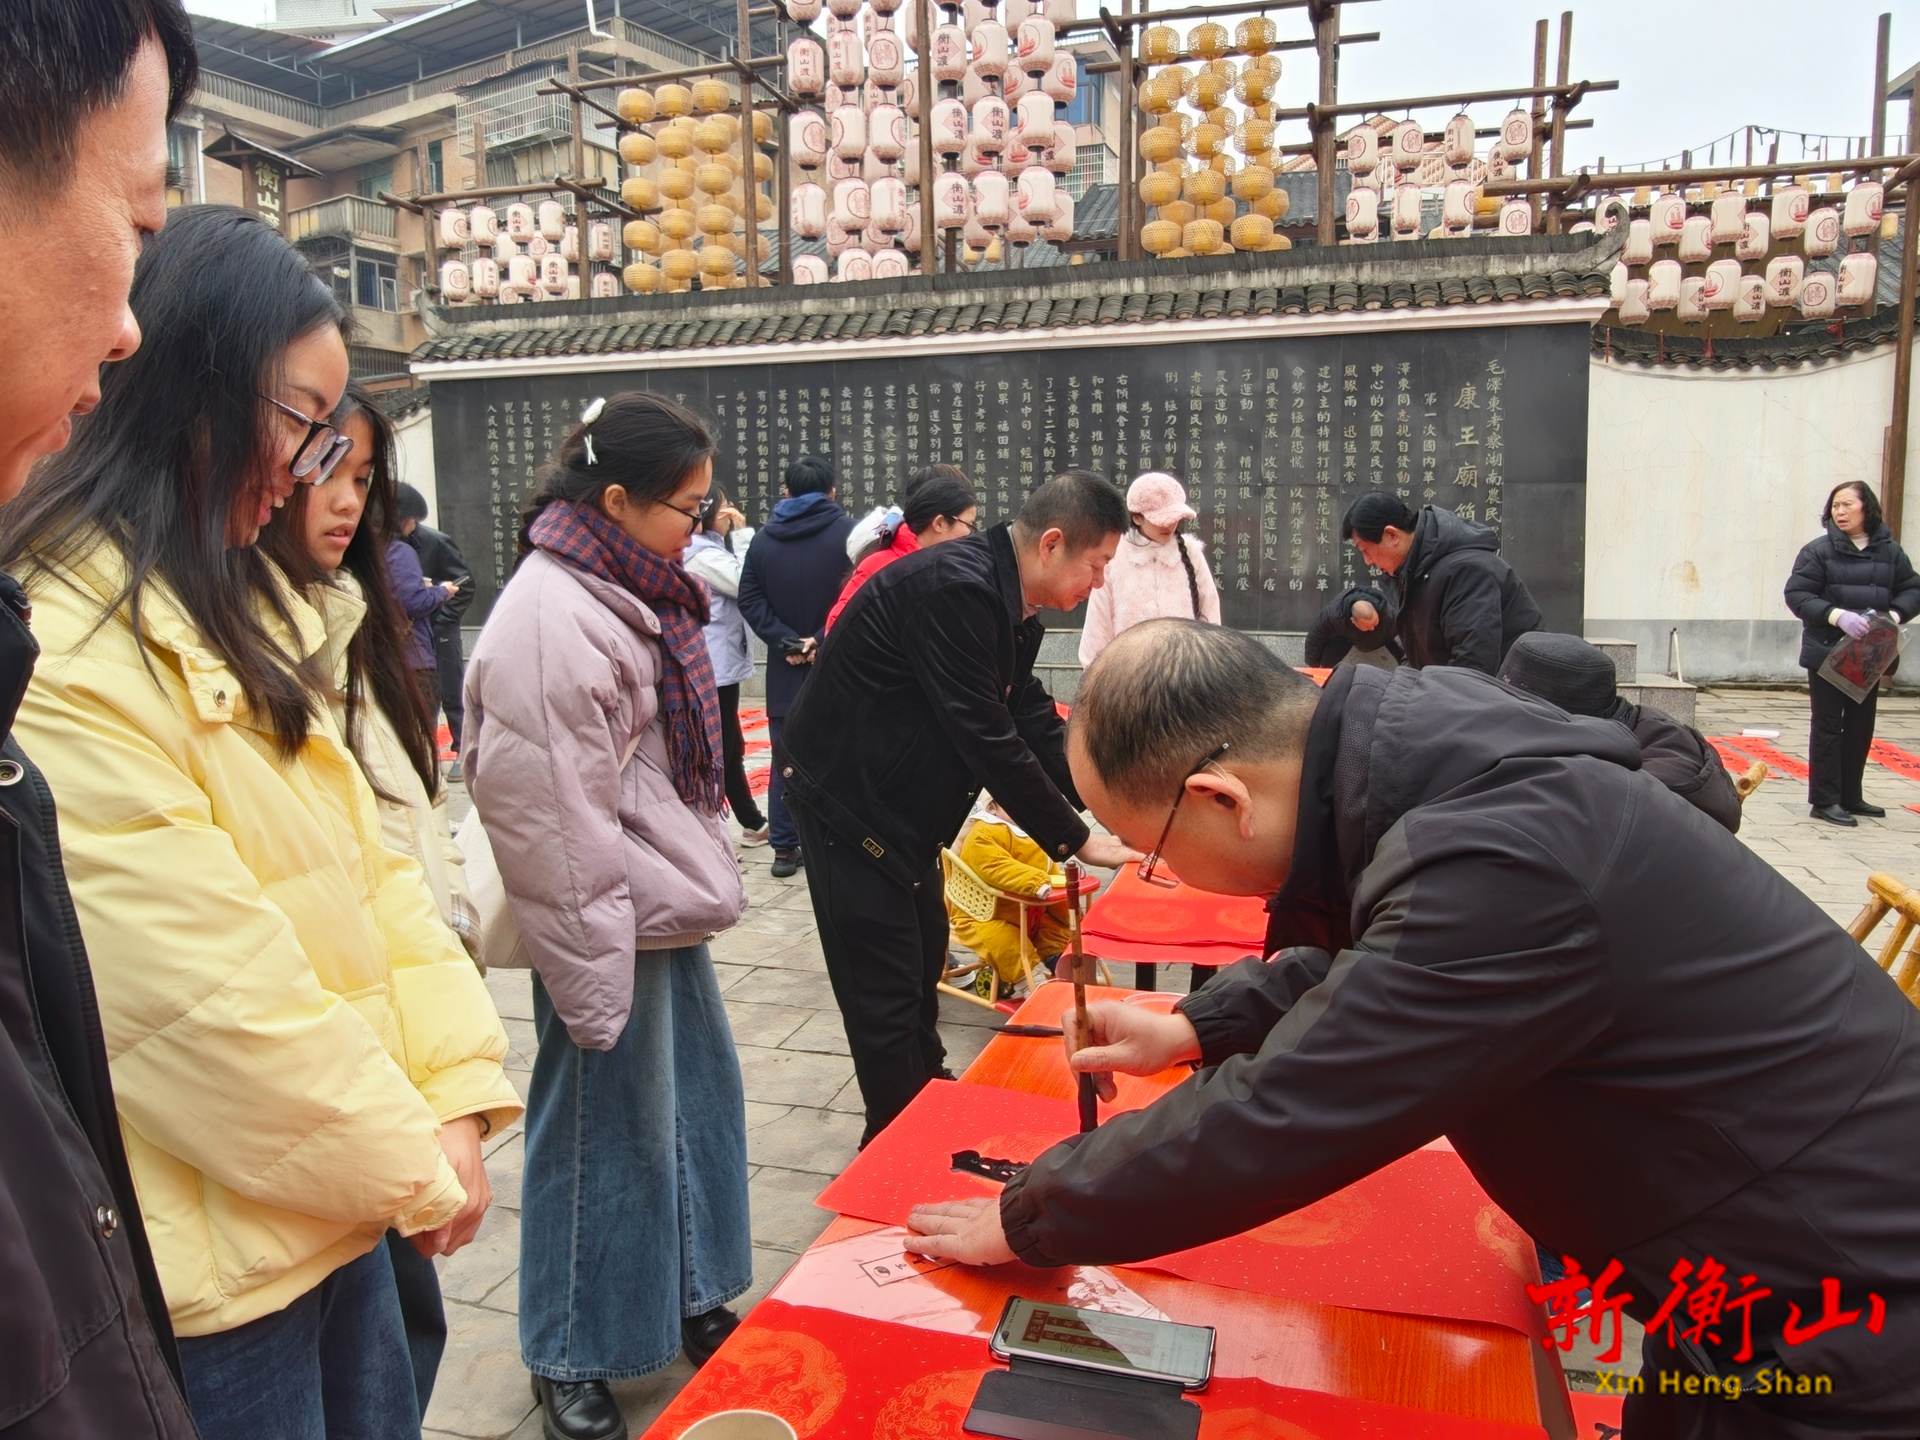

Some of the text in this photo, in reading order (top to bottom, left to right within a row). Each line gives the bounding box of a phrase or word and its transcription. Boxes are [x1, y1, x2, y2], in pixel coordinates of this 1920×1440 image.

[799, 48, 810, 77] 衡山渡
[936, 33, 951, 67] 衡山渡
[952, 108, 965, 141] 衡山渡
[991, 106, 1004, 141] 衡山渡
[951, 182, 964, 216] 衡山渡
[1750, 283, 1763, 311] 衡山渡
[1777, 267, 1793, 297] 衡山渡
[1485, 359, 1504, 557] 毛澤東考察湖南農民
